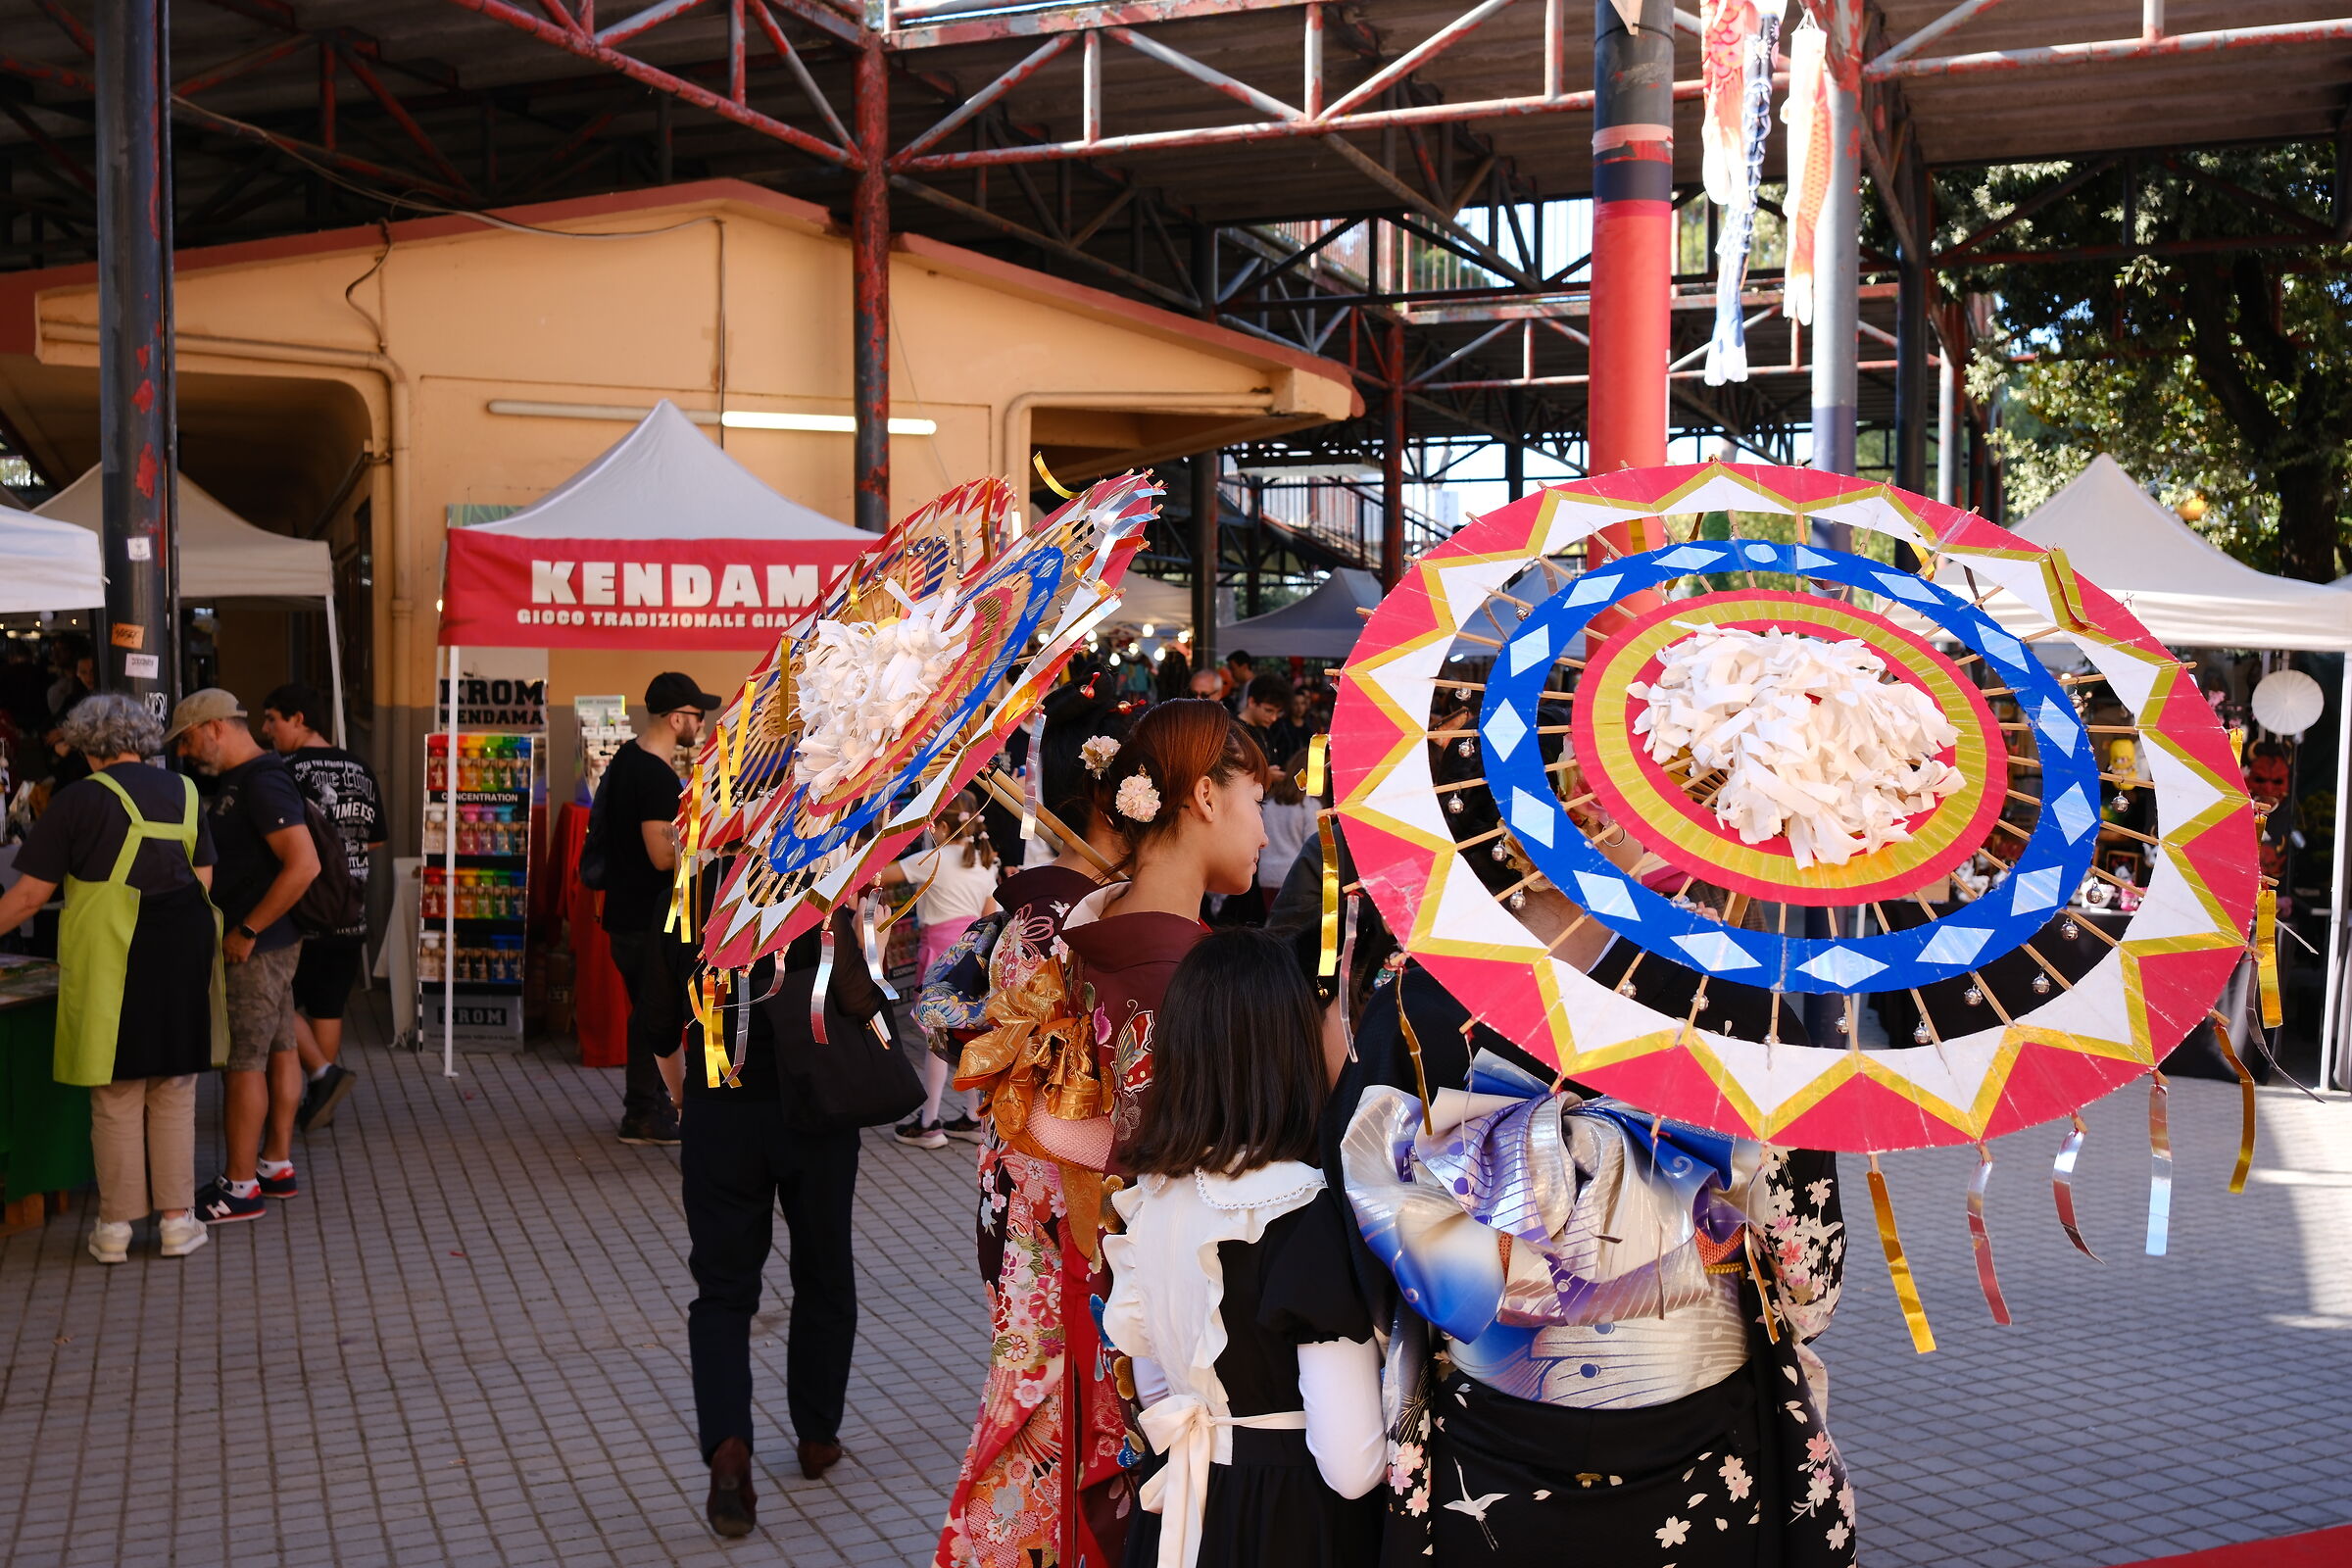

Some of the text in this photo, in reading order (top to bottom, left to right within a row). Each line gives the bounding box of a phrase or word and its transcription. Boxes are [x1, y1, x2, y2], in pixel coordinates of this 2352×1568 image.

[516, 609, 585, 626] GIOCO
[591, 611, 746, 628] TRADIZIONALE
[440, 679, 544, 705] KROM
[442, 792, 518, 802] CNCENTRATION
